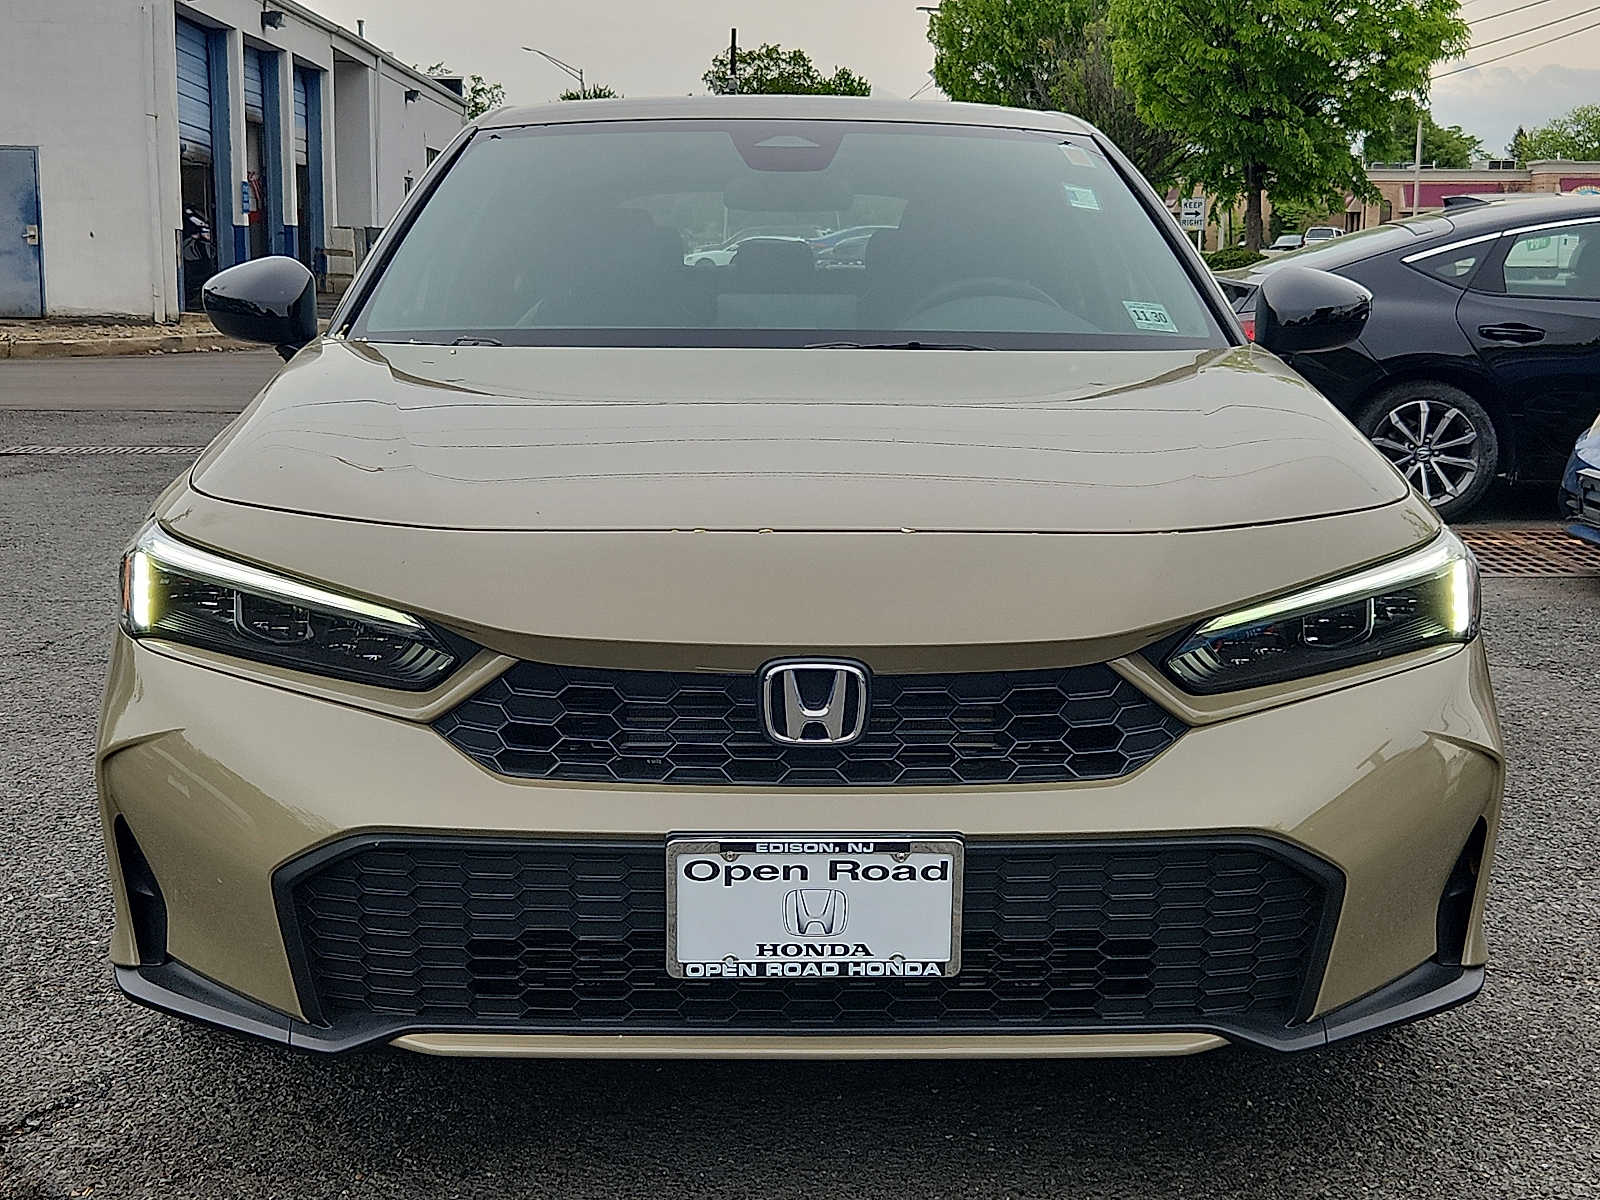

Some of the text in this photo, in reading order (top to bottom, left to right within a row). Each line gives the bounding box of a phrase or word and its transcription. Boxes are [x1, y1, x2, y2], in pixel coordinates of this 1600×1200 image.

[1132, 310, 1168, 323] 11 30
[755, 842, 875, 854] EDISON, NJ
[683, 859, 949, 887] Open Road
[756, 943, 874, 957] HONDA
[685, 962, 942, 977] OPEN ROAD HONDA
